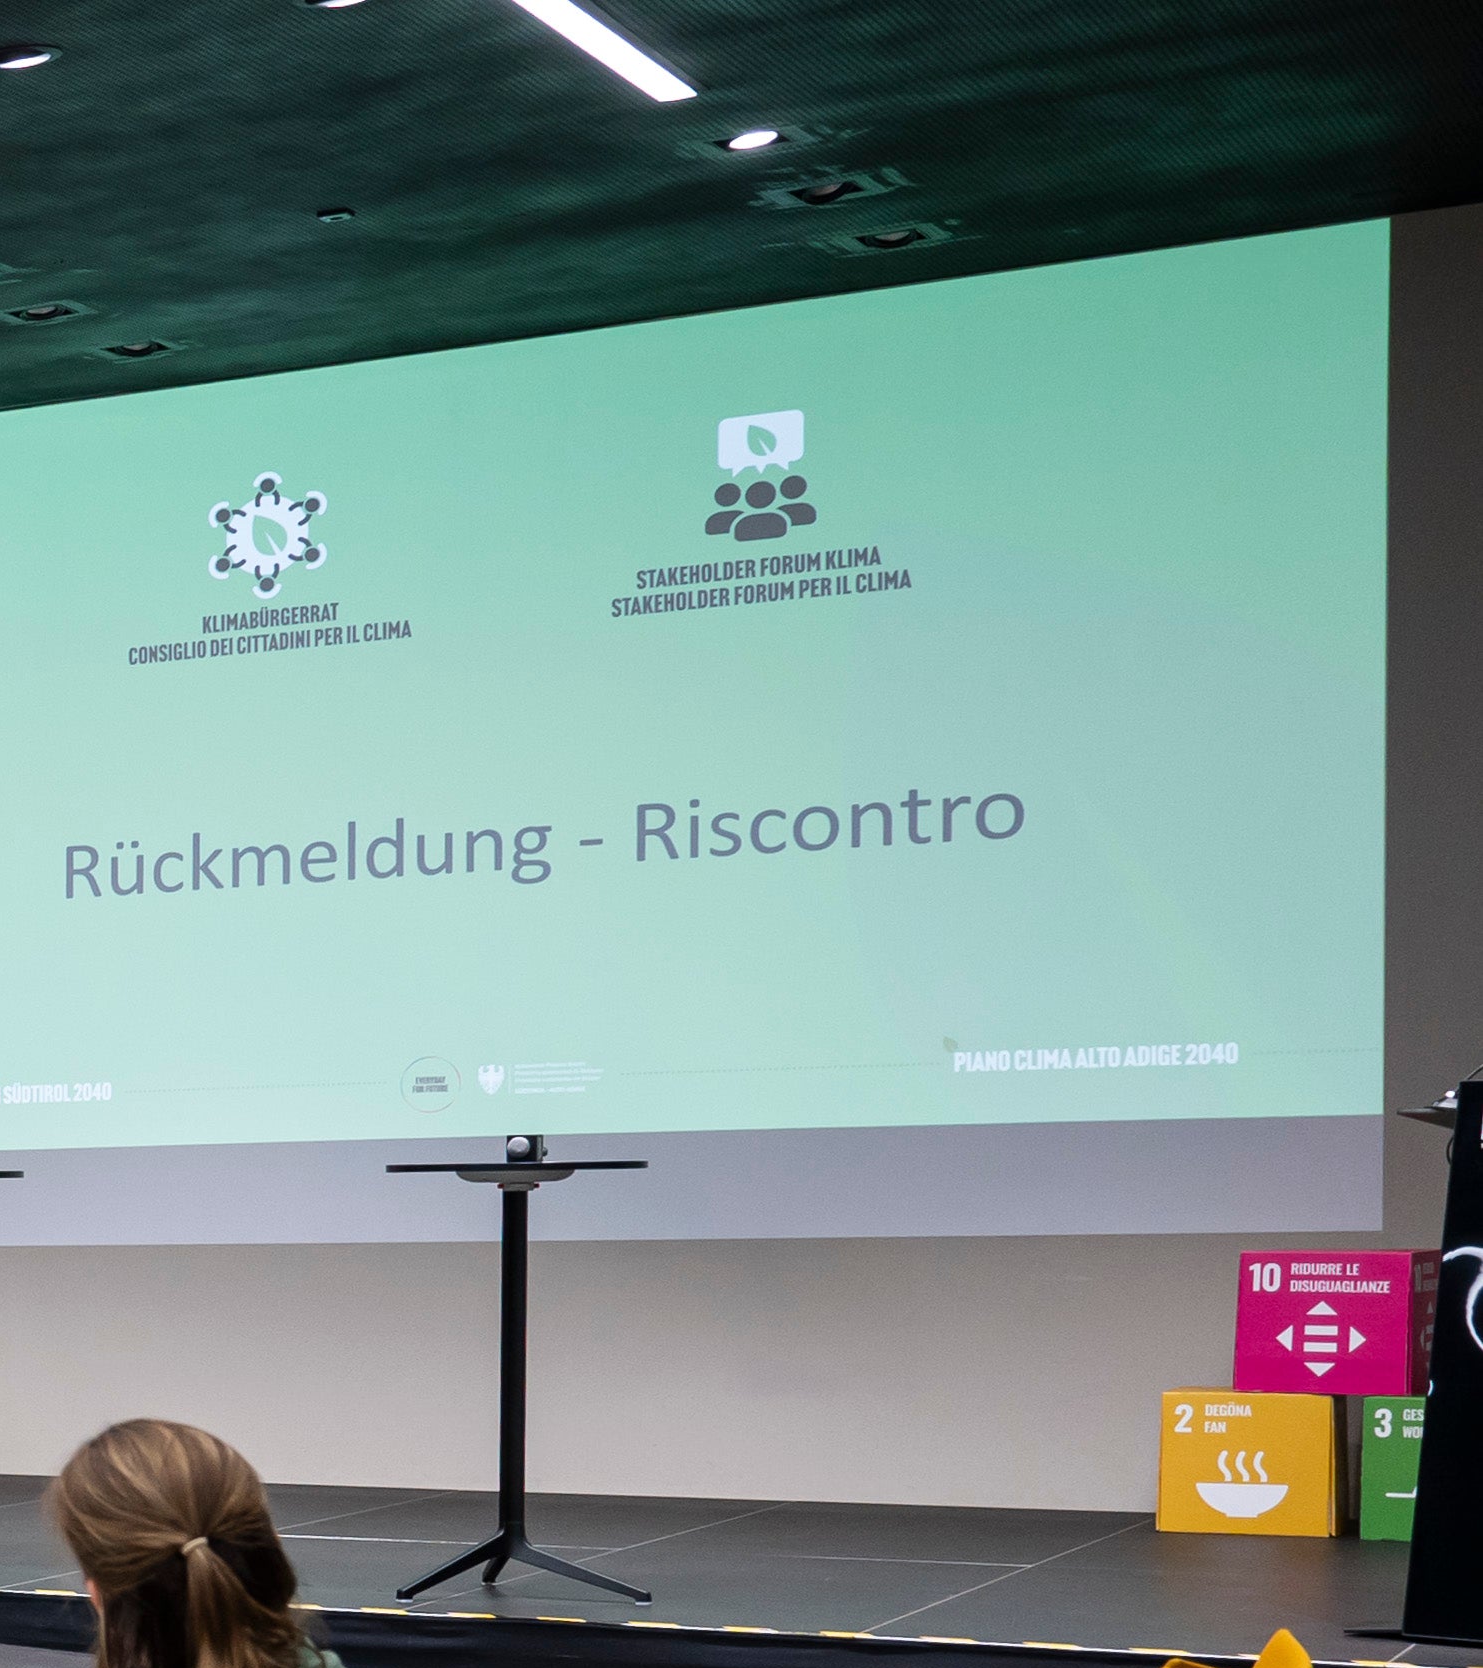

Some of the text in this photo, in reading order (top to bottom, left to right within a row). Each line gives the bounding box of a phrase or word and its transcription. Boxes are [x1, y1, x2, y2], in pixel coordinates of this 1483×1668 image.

[636, 545, 882, 590] STAKEHOLDER FORUM KLIMA
[611, 569, 912, 617] STAKEHOLDER FORUM PER IL CLIMA
[202, 602, 339, 634] KLIMABÜRGERRAT
[128, 620, 412, 665] CONSIGLIO DEI CITTADINI PER IL CLIMA
[64, 817, 553, 900] Rückmeldung
[635, 788, 1026, 862] Riscontro
[954, 1042, 1239, 1073] PIANO CLIMA ALTO ADIGE 2040
[3, 1082, 71, 1104] SÜDTIROL
[73, 1082, 113, 1101] 2040
[1249, 1262, 1360, 1292] 10 RIDURRE LE
[1289, 1280, 1391, 1294] DISUGUAGLIANZE
[1173, 1403, 1252, 1434] 2 DEGÖNA
[1204, 1421, 1227, 1434] FAN
[1373, 1408, 1393, 1438] 3
